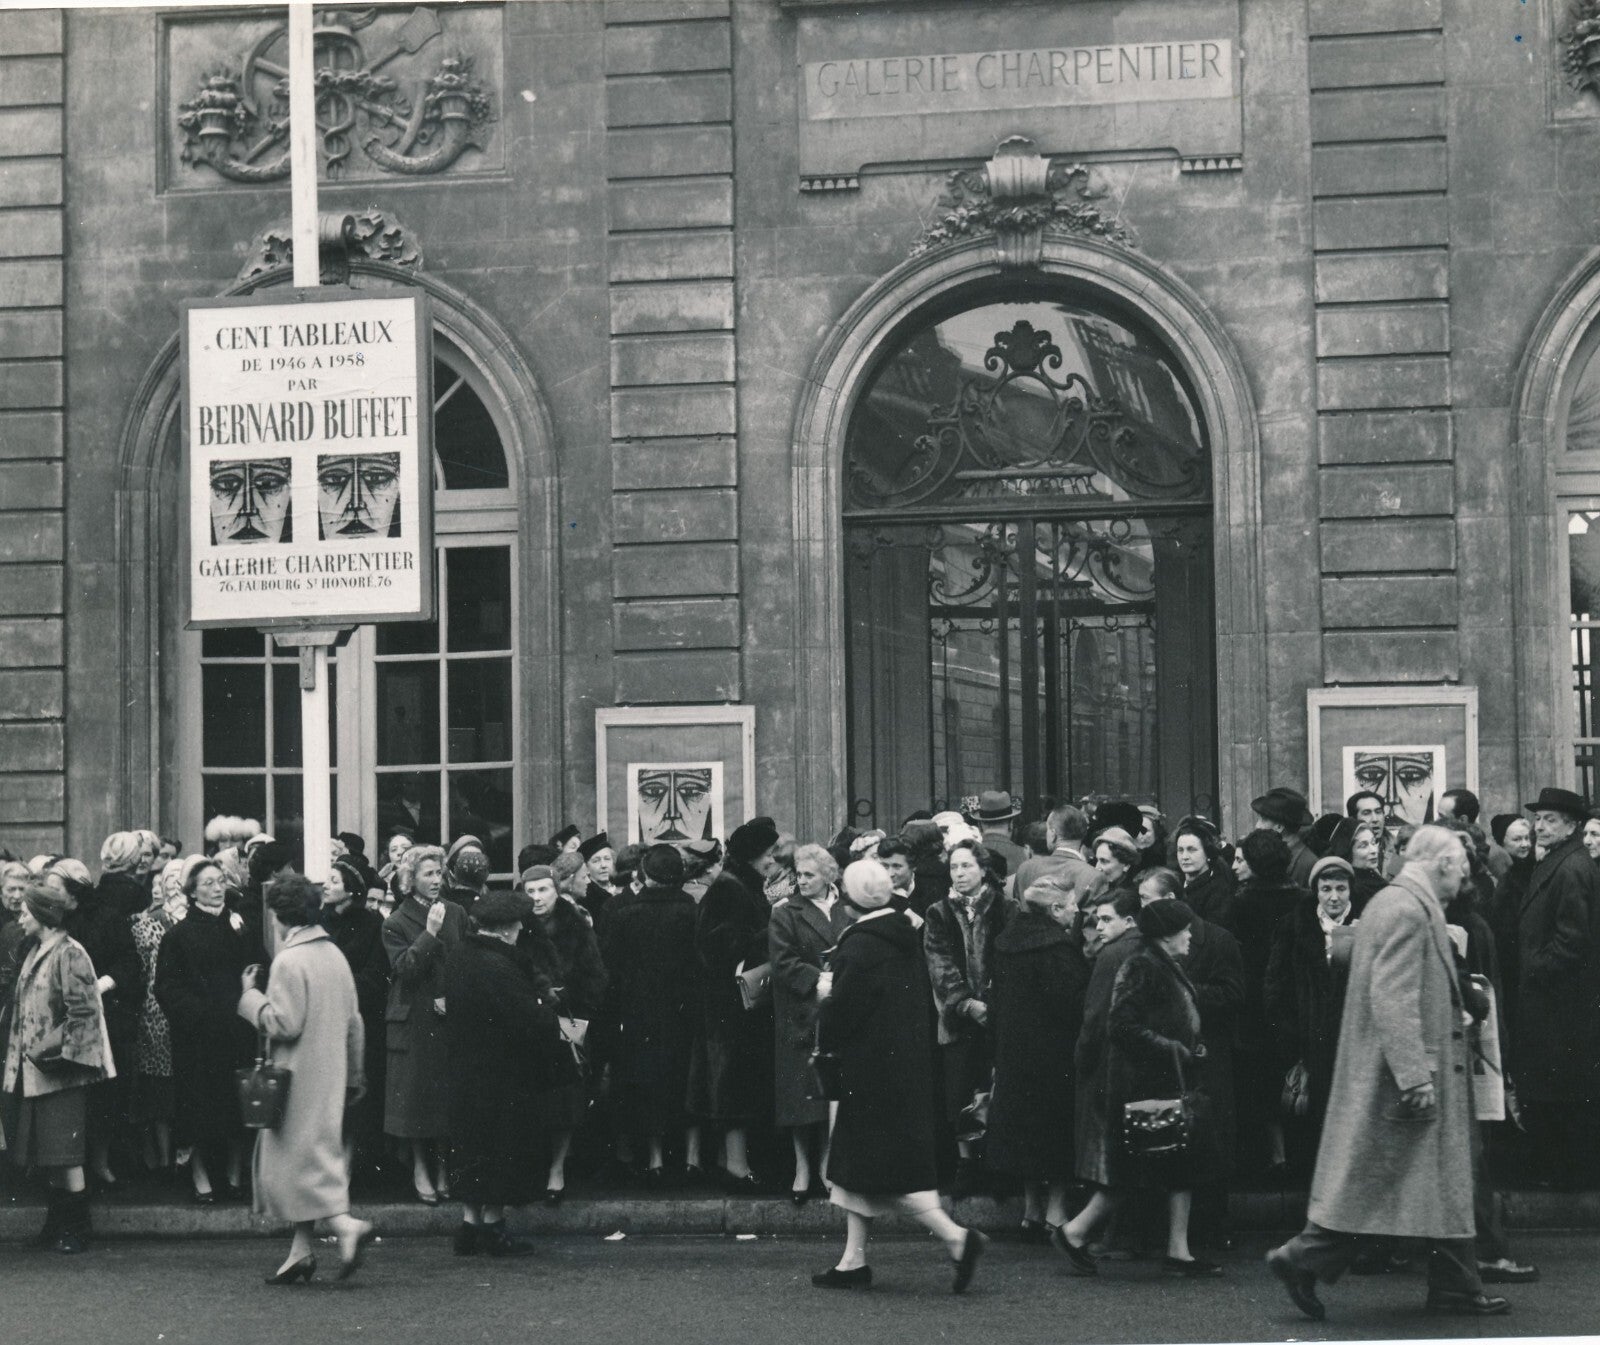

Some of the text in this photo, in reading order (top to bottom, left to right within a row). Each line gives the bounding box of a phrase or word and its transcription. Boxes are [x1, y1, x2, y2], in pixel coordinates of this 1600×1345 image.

[817, 42, 1225, 98] GALERIE CHARPENTIER
[215, 319, 393, 350] CENT TABLEAUX
[242, 354, 365, 372] DE 1946 A 1958
[287, 378, 318, 391] PAR
[198, 396, 412, 446] BERNARD BUFFET
[199, 551, 414, 578] GALERIE CHARPENTIER
